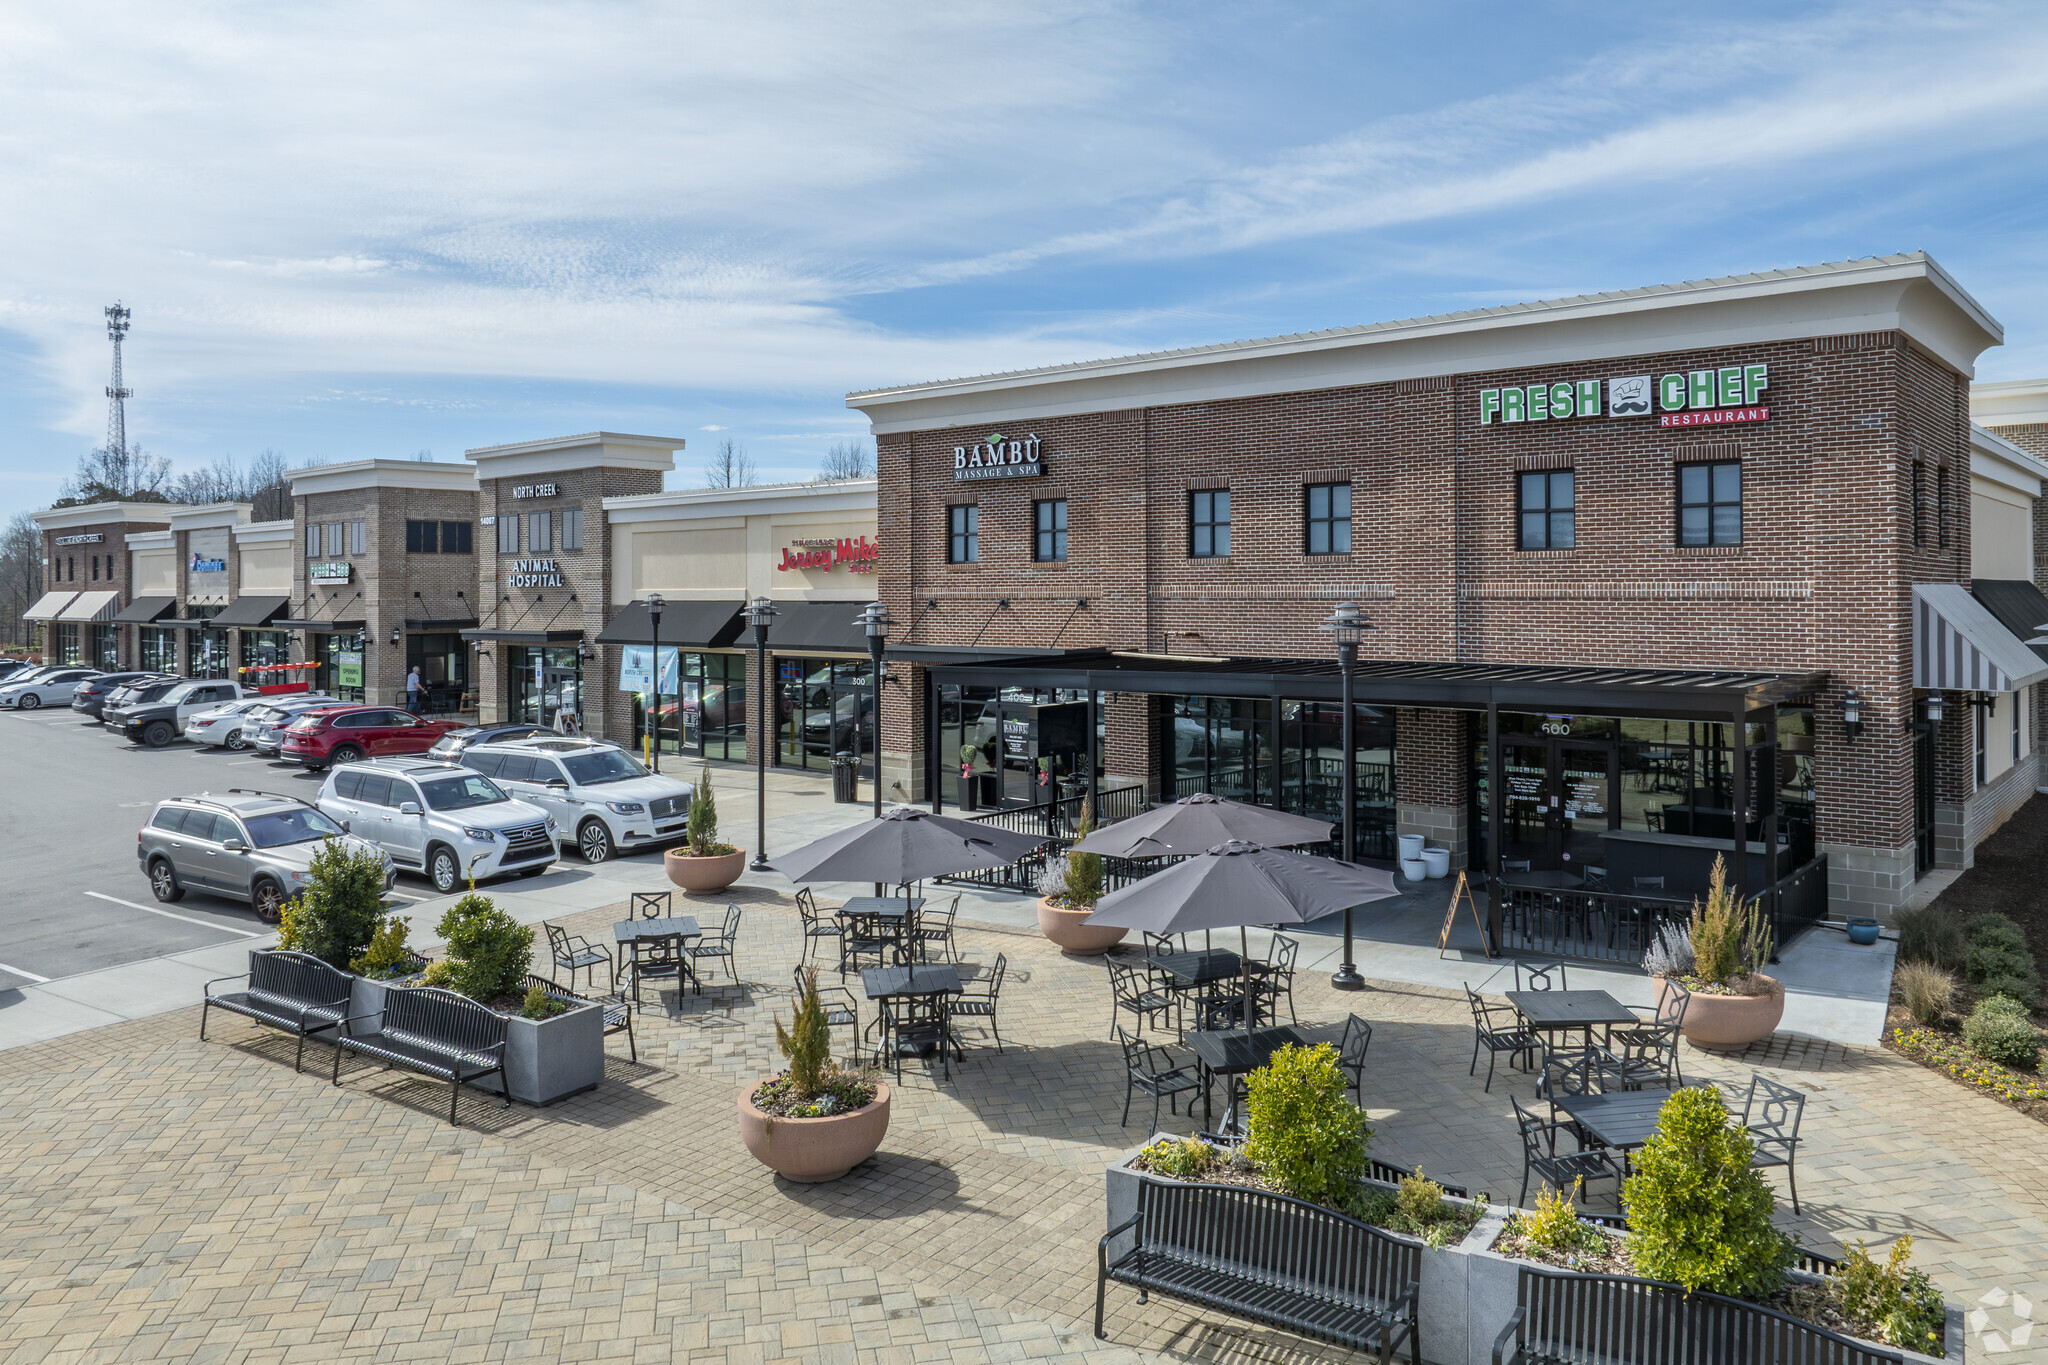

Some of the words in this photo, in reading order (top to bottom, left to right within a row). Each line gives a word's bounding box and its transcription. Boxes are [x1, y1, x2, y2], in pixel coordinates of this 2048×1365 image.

[1480, 380, 1601, 424] FRESH
[1660, 364, 1767, 411] CHEF
[1661, 409, 1768, 426] RESTAURANT
[954, 433, 1041, 469] BAMBÙ
[955, 468, 1002, 480] MASSAGE
[1007, 466, 1013, 476] &
[1019, 466, 1038, 475] SPA
[513, 486, 534, 499] NORTH
[535, 484, 557, 497] CREEK
[512, 560, 556, 572] ANIMAL
[777, 547, 832, 573] Jersey
[848, 565, 871, 573] SUBS
[508, 574, 562, 587] HOSPITAL
[852, 677, 866, 686] 300
[1008, 693, 1025, 703] 400
[1542, 723, 1569, 735] 600
